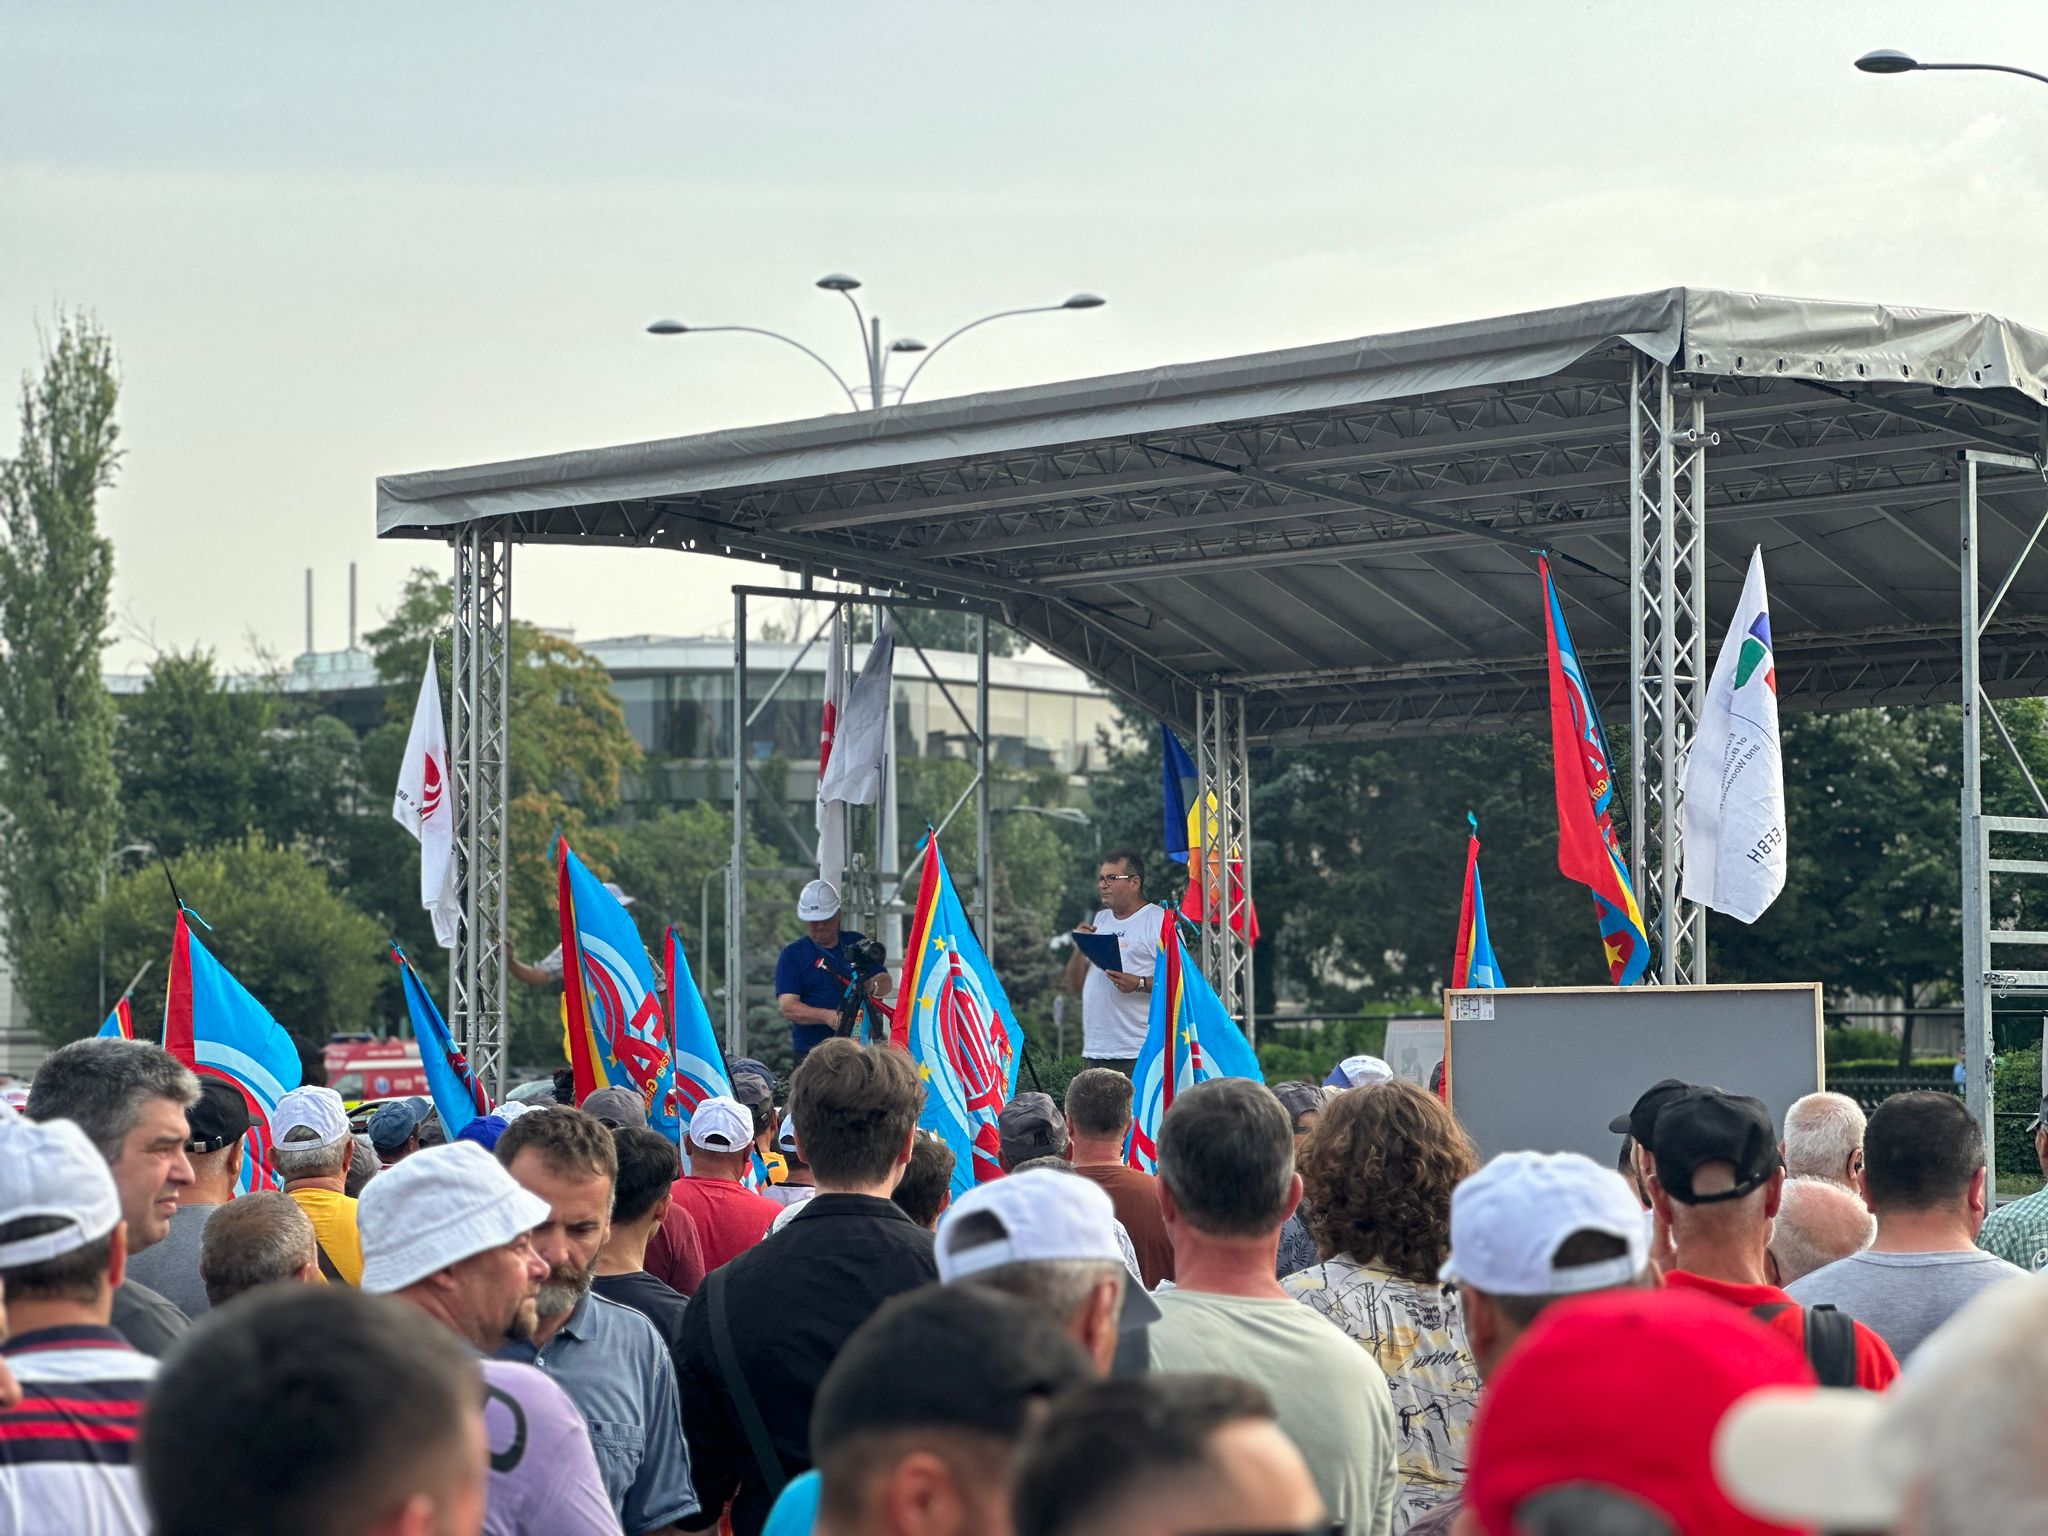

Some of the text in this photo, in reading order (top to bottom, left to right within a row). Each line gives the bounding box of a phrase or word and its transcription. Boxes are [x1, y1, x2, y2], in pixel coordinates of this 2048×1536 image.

[1389, 1294, 1441, 1314] FREEDOM
[1414, 1318, 1442, 1331] MOOD
[1423, 1313, 1441, 1323] MY
